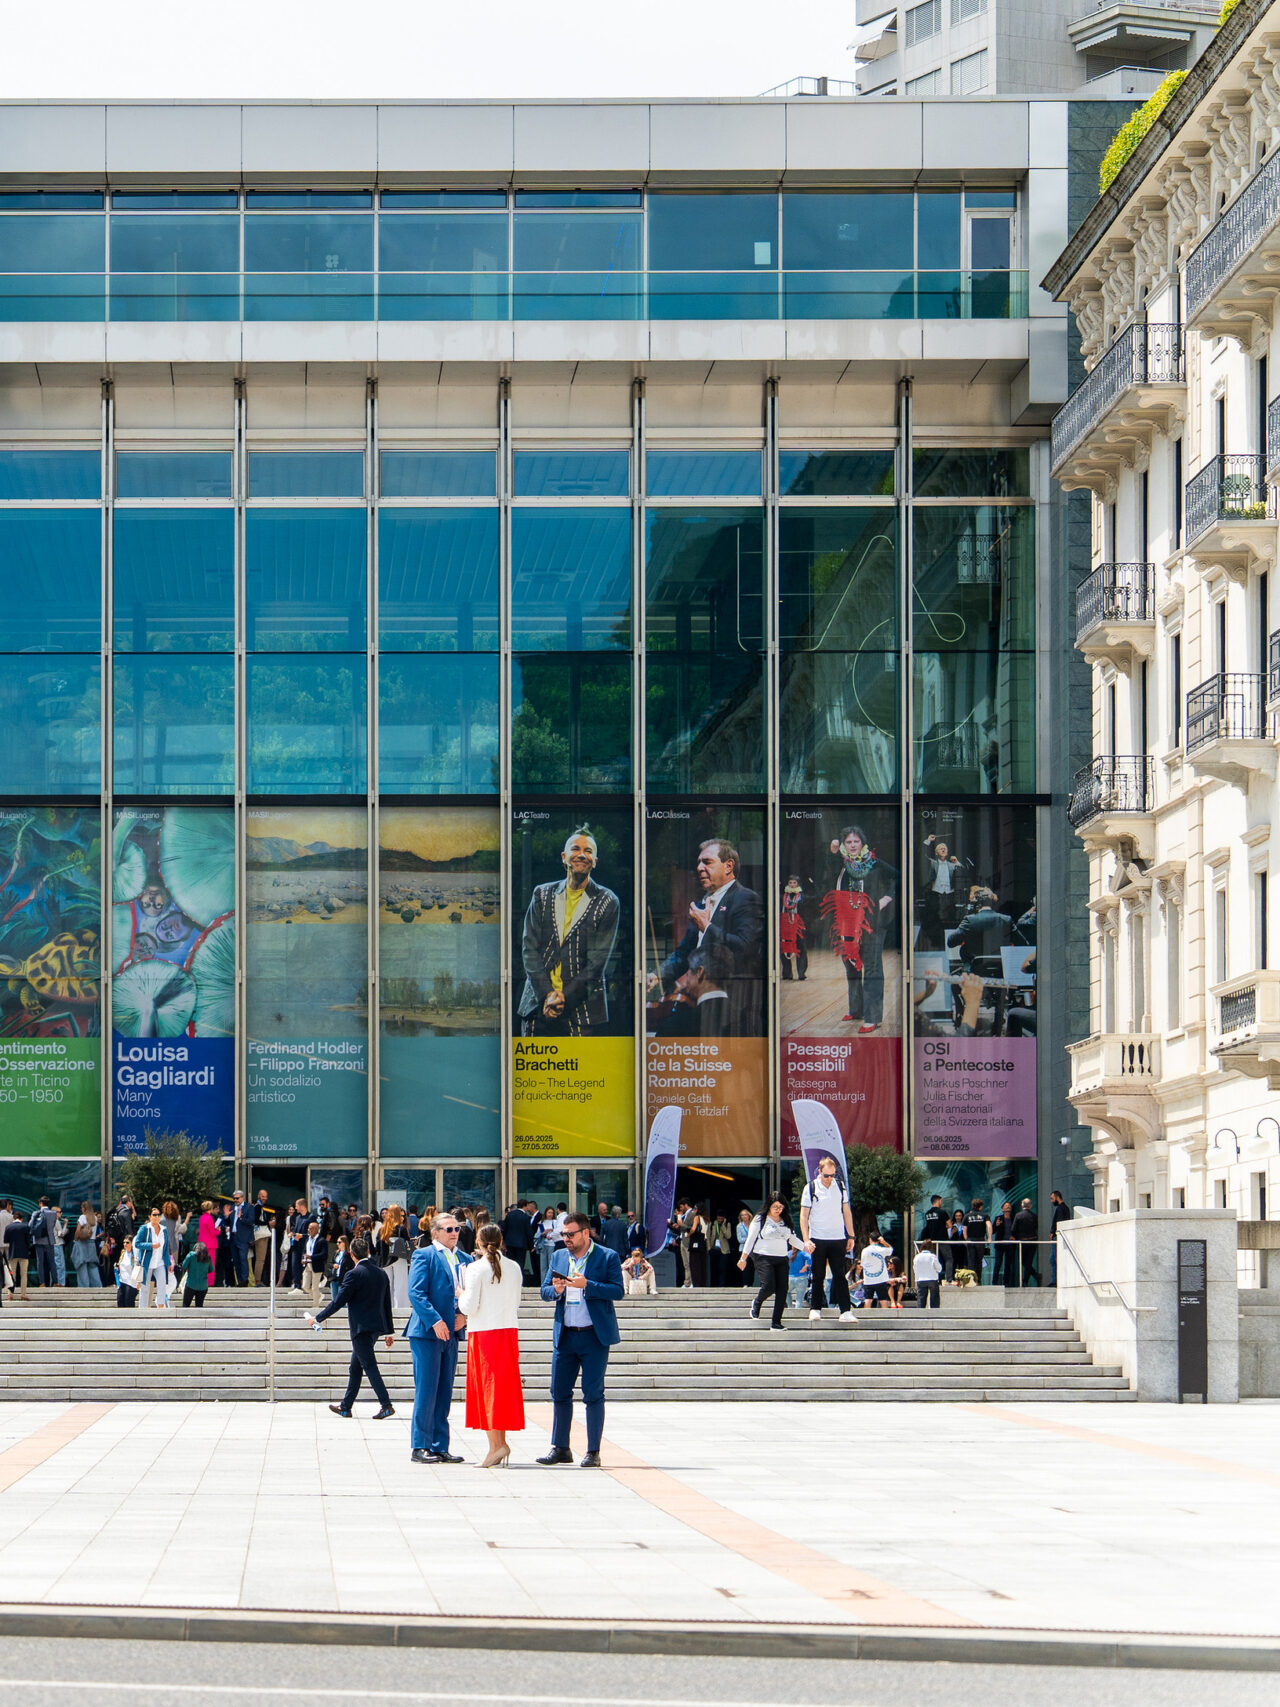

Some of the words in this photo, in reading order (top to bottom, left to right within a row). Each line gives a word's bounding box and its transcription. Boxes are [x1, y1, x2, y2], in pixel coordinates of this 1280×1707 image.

[118, 1042, 189, 1062] Louisa
[248, 1042, 314, 1054] Ferdinand
[318, 1042, 363, 1054] Hodler
[515, 1042, 559, 1055] Arturo
[648, 1042, 719, 1056] Orchestre
[787, 1043, 852, 1058] Paesaggi
[924, 1043, 950, 1055] OSI
[260, 1058, 304, 1072] Filippo
[309, 1058, 364, 1070] Franzoni
[515, 1059, 578, 1071] Brachetti
[648, 1059, 666, 1072] de
[669, 1059, 681, 1072] la
[684, 1059, 733, 1072] Suisse
[787, 1059, 845, 1074] possibili
[923, 1062, 932, 1072] a
[936, 1059, 1015, 1072] Pentecoste
[17, 1074, 28, 1087] in
[32, 1073, 70, 1087] Ticino
[117, 1066, 215, 1090] Gagliardi
[248, 1074, 266, 1087] Un
[270, 1074, 321, 1087] sodalizio
[515, 1078, 537, 1088] Solo
[547, 1078, 566, 1088] The
[568, 1077, 605, 1090] Legend
[648, 1075, 716, 1088] Romande
[924, 1078, 960, 1088] Markus
[962, 1078, 1008, 1088] Poschner
[787, 1079, 837, 1091] Rassegna
[117, 1089, 153, 1106] Many
[248, 1090, 296, 1103] artistico
[515, 1090, 526, 1101] of
[526, 1090, 593, 1103] quick-change
[648, 1093, 686, 1104] Daniele
[688, 1093, 712, 1104] Gatti
[787, 1091, 796, 1101] di
[798, 1091, 866, 1104] drammaturgia
[923, 1091, 946, 1101] Julia
[948, 1091, 984, 1101] Fischer
[117, 1105, 161, 1118] Moons
[694, 1105, 729, 1116] Tetzlaff
[923, 1104, 944, 1114] Cori
[945, 1104, 993, 1114] amatoriali
[923, 1117, 947, 1127] della
[949, 1116, 988, 1127] Svizzera
[990, 1117, 1024, 1127] italiana
